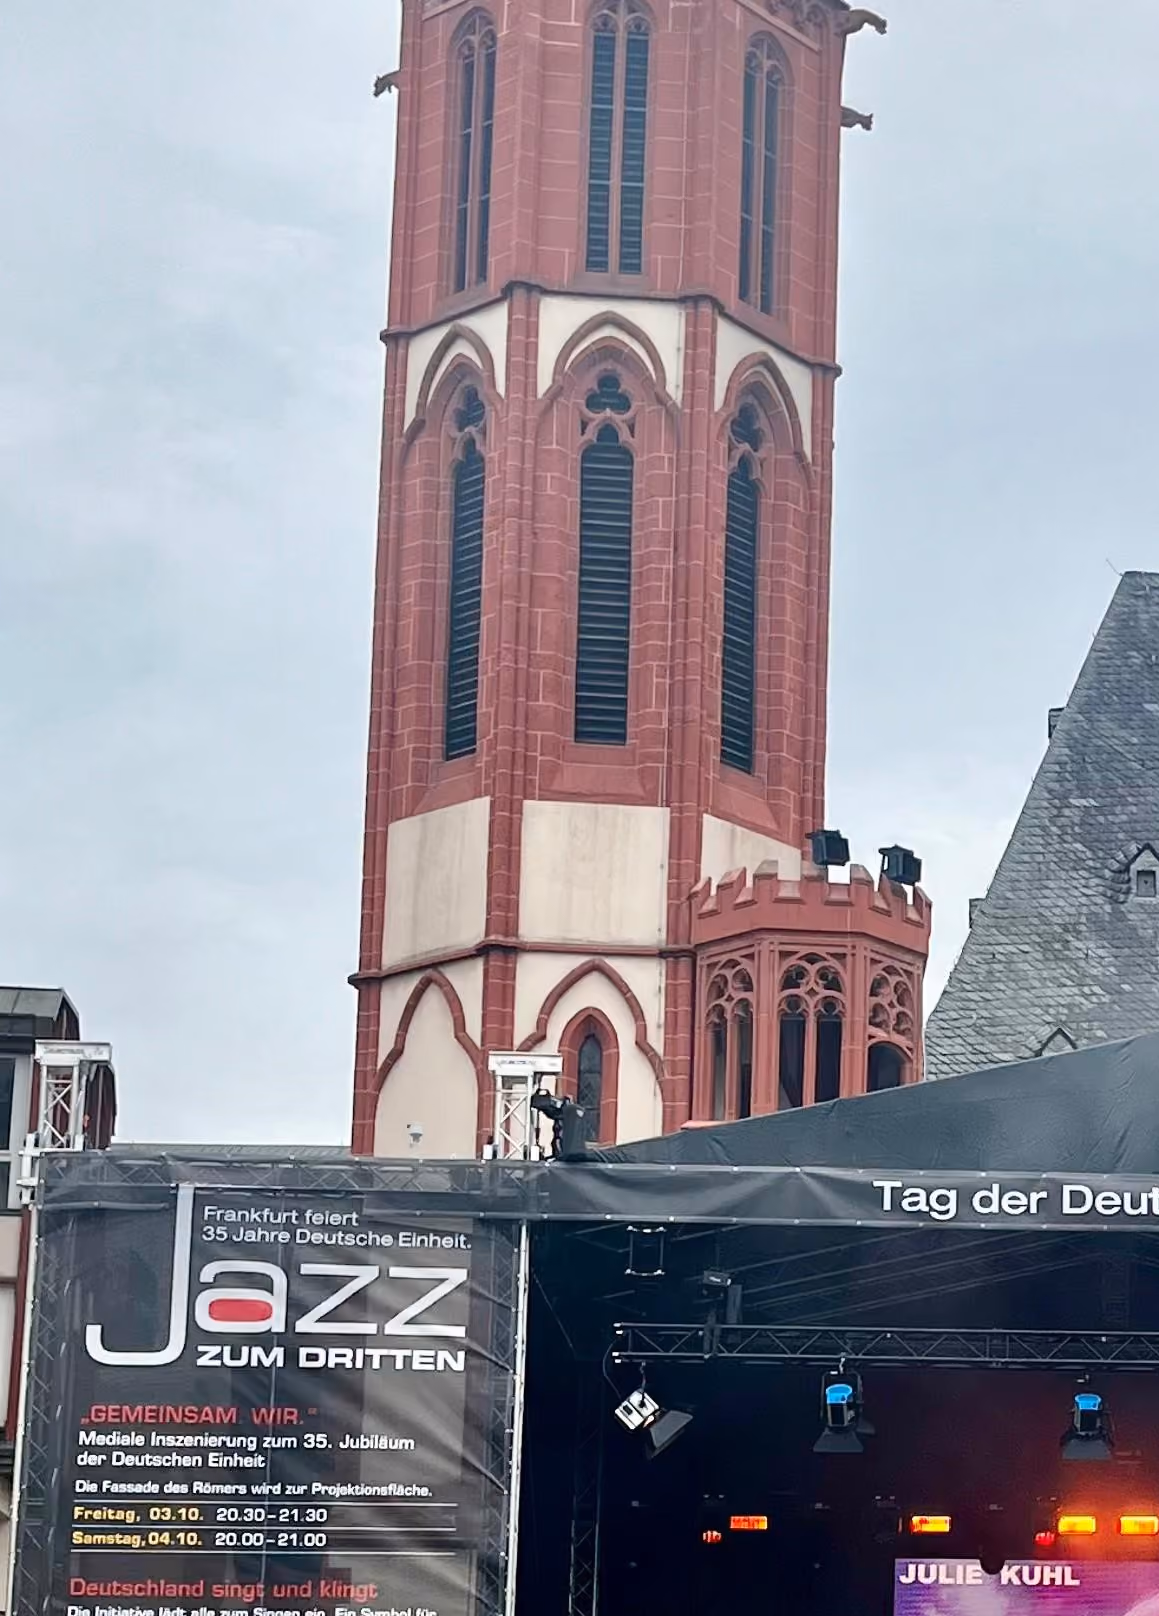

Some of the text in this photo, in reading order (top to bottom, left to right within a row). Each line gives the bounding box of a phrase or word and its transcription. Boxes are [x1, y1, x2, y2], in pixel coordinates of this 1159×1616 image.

[872, 1179, 957, 1220] Tag
[971, 1183, 1047, 1215] der
[203, 1205, 359, 1227] Frankfurt feiert
[202, 1226, 472, 1250] 35 Jahre Deutsche Einheit.
[85, 1184, 469, 1367] Jazz
[196, 1345, 466, 1371] ZUM DRITTEN
[78, 1431, 415, 1450] Mediale Inszenierung zum 35. Jubiläum
[77, 1451, 266, 1468] der Deutschen Einheit
[75, 1480, 432, 1498] Die Fassade des Römers wird zur Projektionsfläche.
[73, 1506, 141, 1524] Freitag,
[149, 1508, 203, 1521] 03.10.
[899, 1563, 1081, 1586] JULIE KUHL
[70, 1578, 378, 1603] Deutschland singt und klingt
